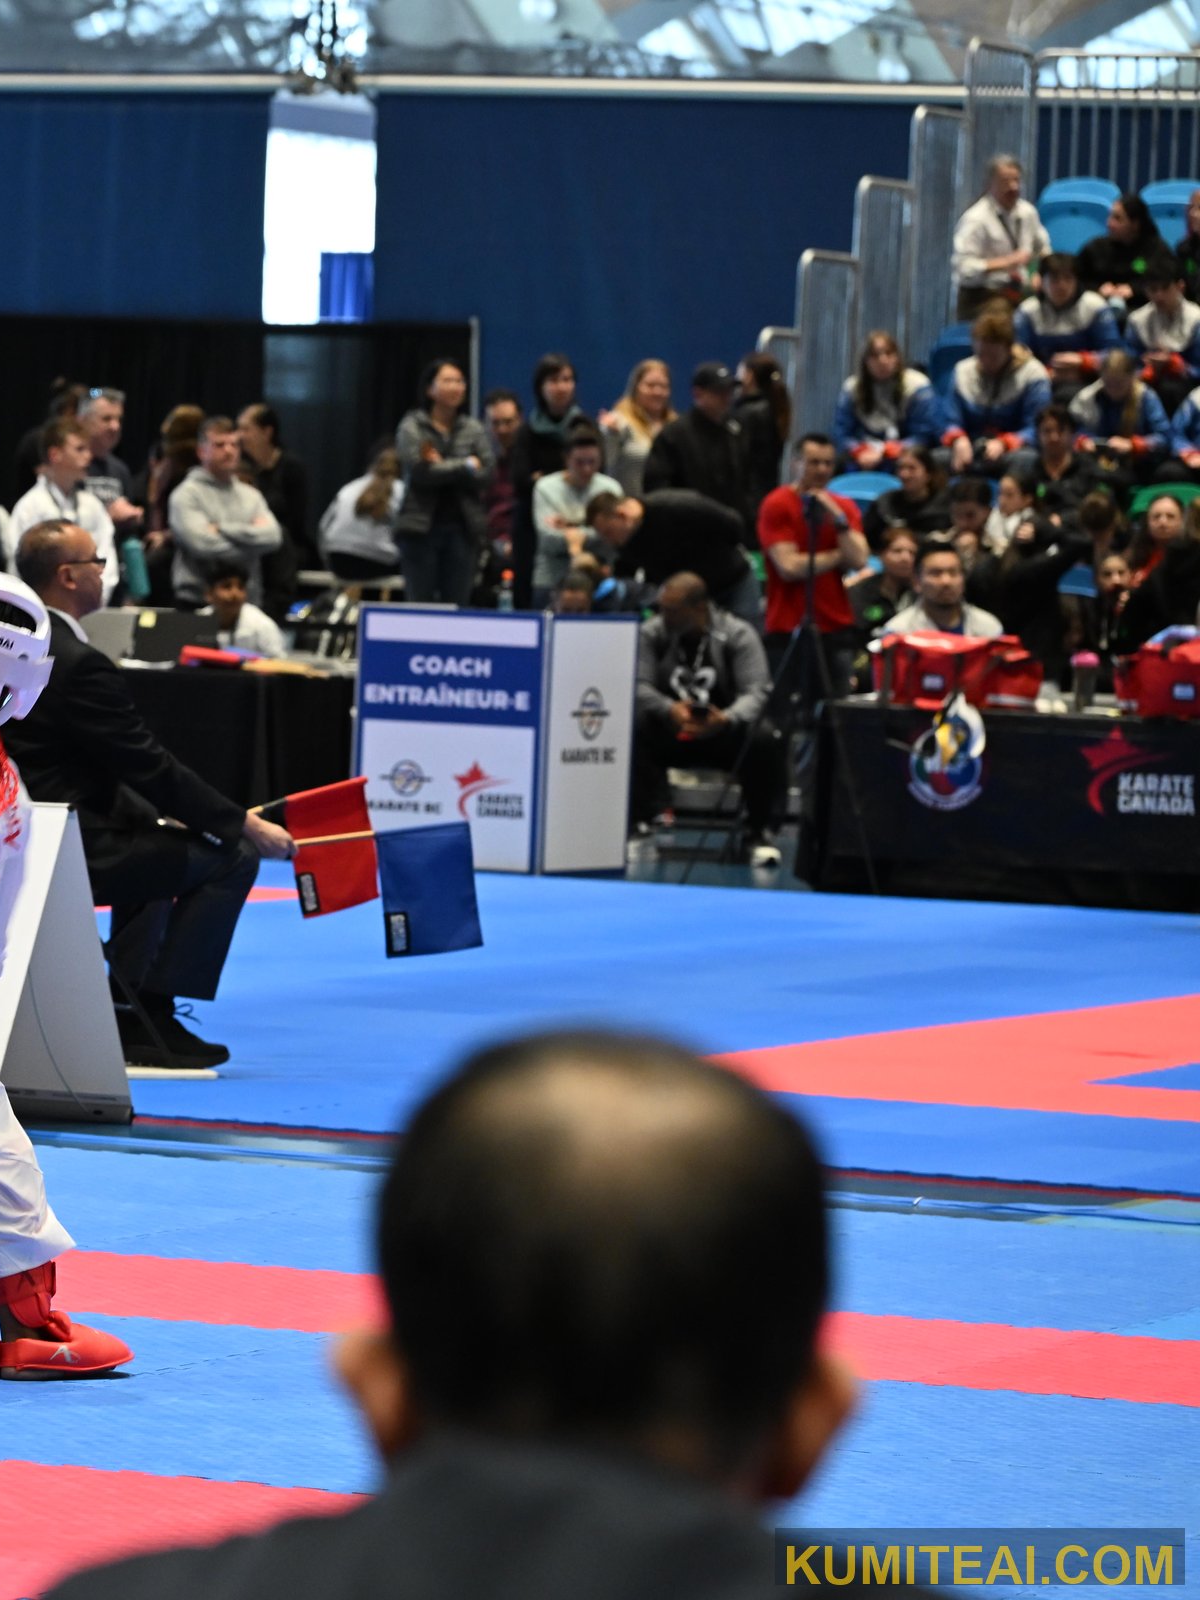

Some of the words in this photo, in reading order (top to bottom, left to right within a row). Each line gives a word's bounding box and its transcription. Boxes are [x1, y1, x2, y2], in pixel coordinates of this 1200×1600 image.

[409, 655, 492, 678] COACH
[1118, 773, 1194, 795] KARATE
[1118, 795, 1195, 816] CANADA
